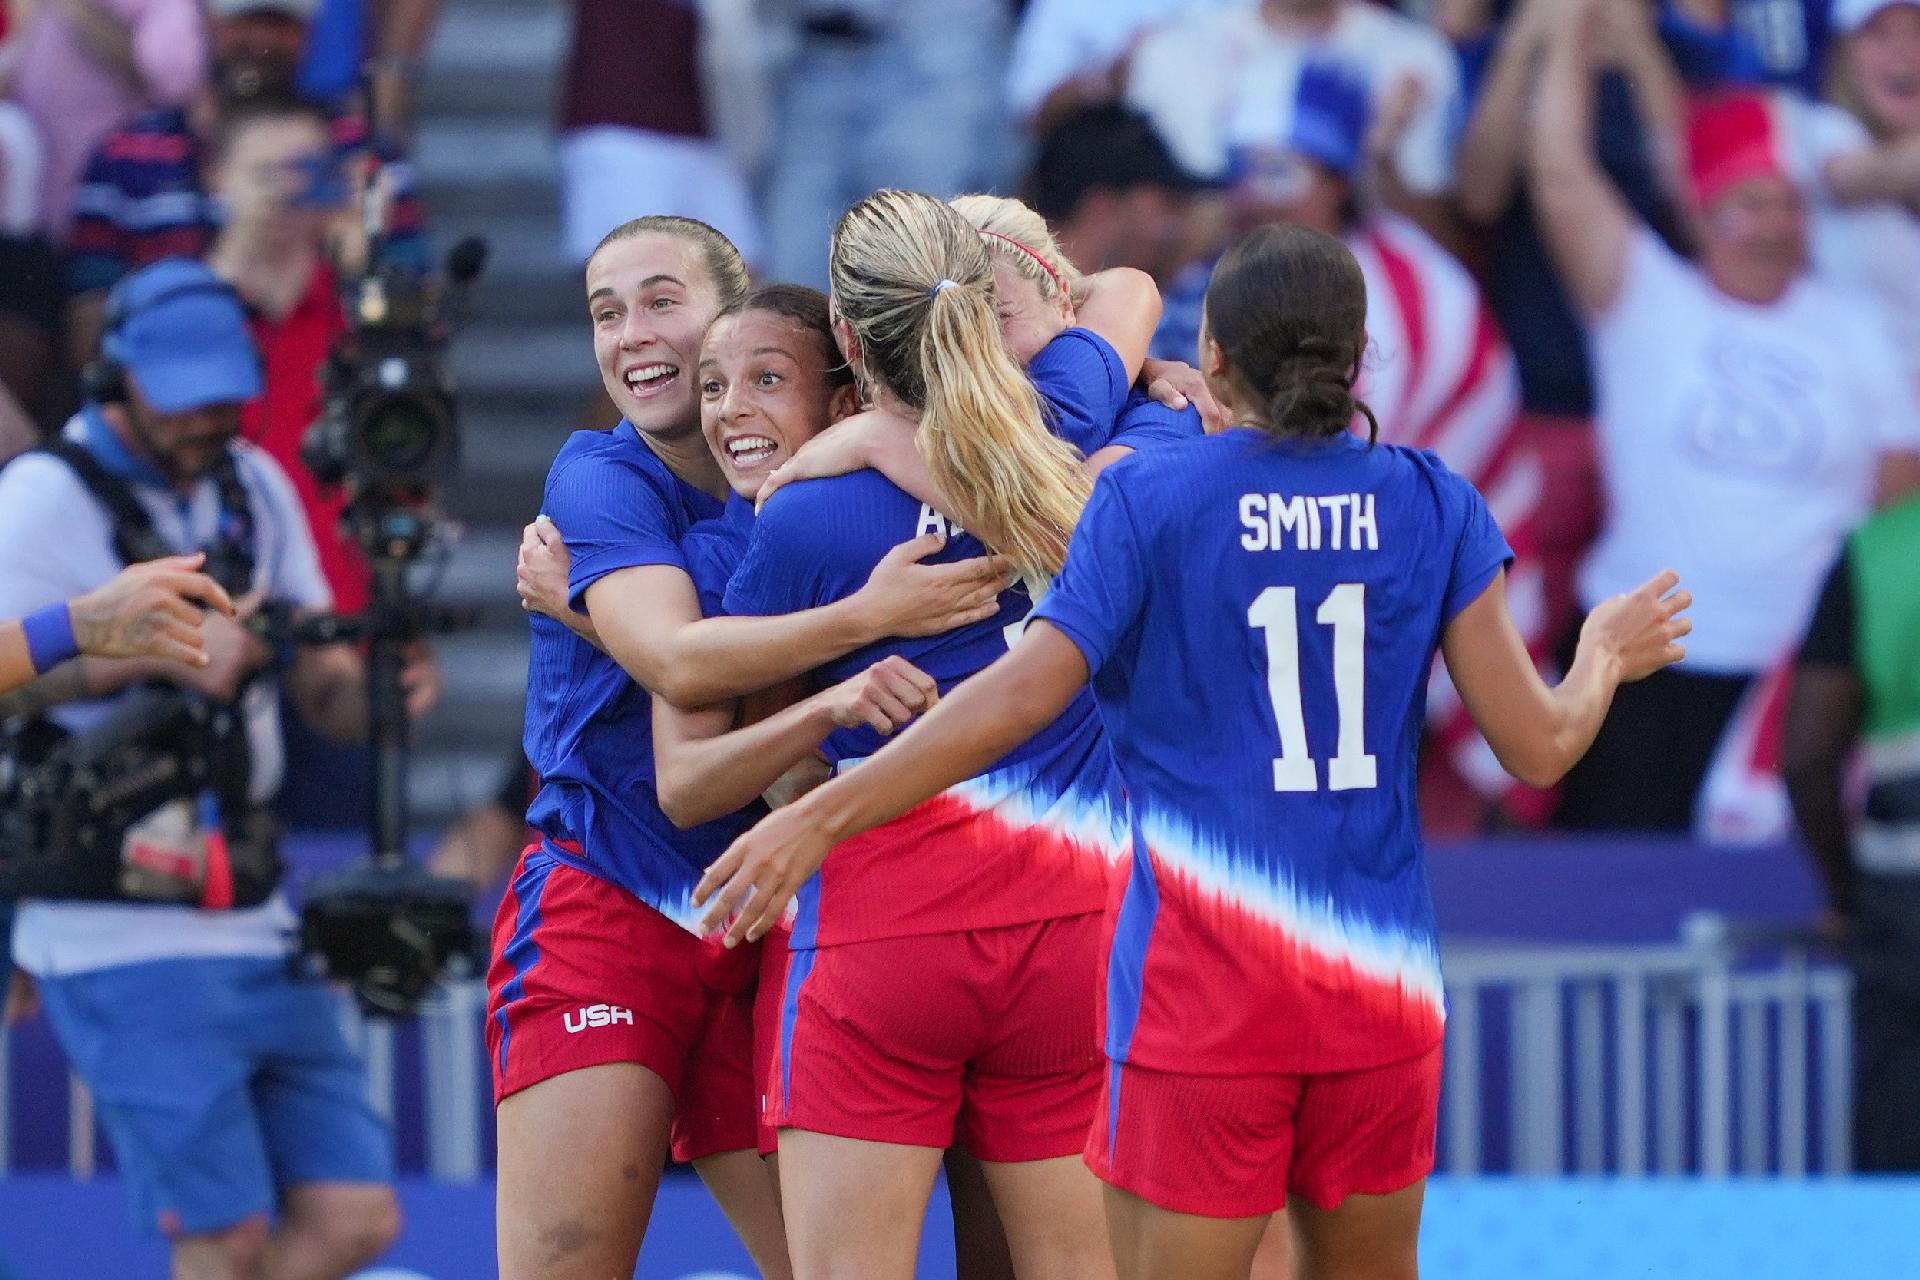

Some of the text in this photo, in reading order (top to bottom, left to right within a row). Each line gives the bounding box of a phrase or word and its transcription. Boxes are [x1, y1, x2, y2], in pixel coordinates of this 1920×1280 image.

[1239, 493, 1379, 551] SMITH
[1248, 583, 1377, 791] 11
[563, 1004, 633, 1033] USA
